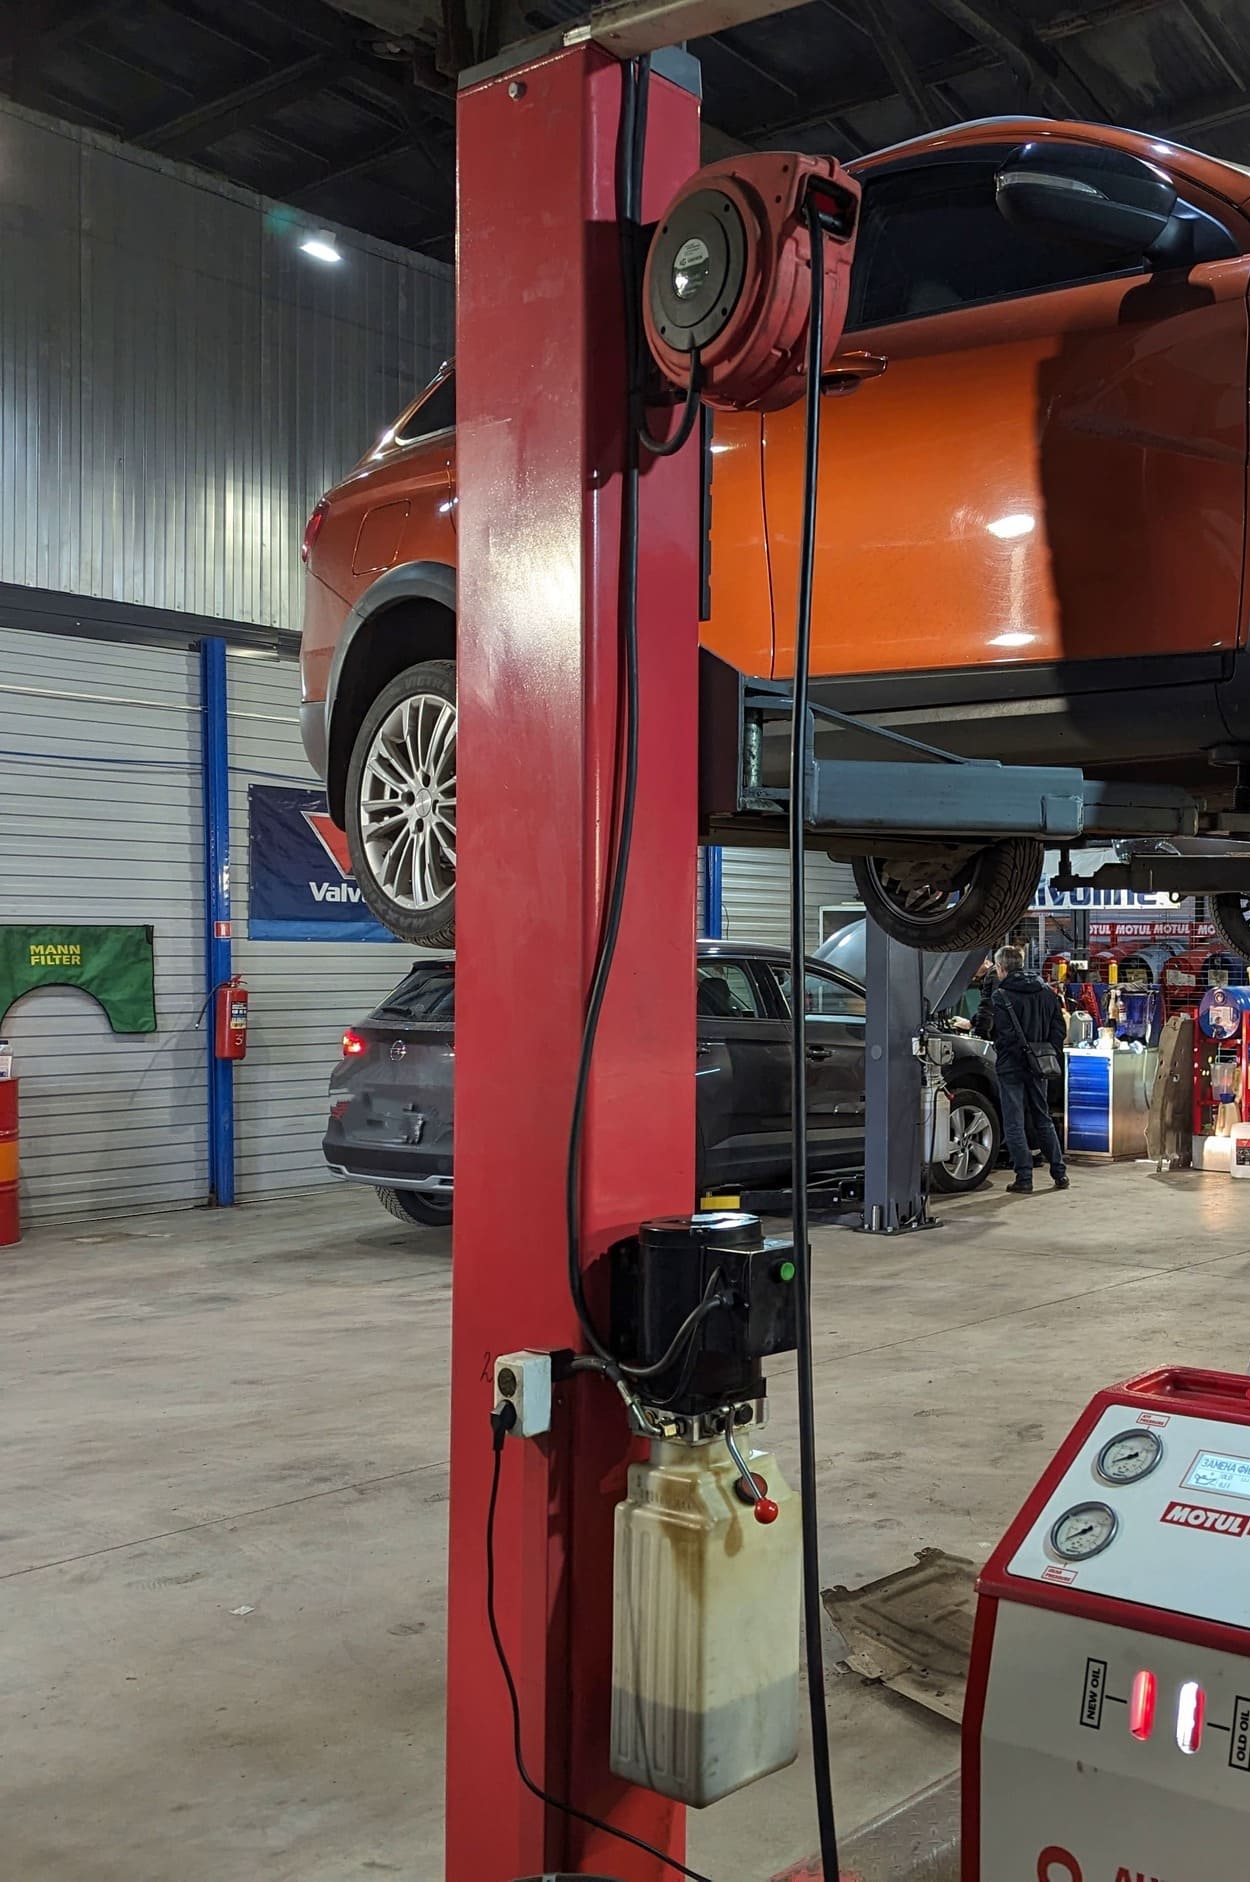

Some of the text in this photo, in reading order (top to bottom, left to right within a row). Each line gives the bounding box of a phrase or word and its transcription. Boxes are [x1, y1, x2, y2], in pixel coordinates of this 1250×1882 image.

[1115, 925, 1151, 935] MOTUL
[1153, 924, 1190, 935] MOTUL
[30, 944, 80, 955] MANN
[31, 955, 81, 966] FILTER
[1201, 1459, 1236, 1473] ЗАМЕНА
[1165, 1505, 1244, 1534] MOTUL
[1087, 1668, 1101, 1720] NEW OIL
[1236, 1710, 1250, 1762] OLD OIL
